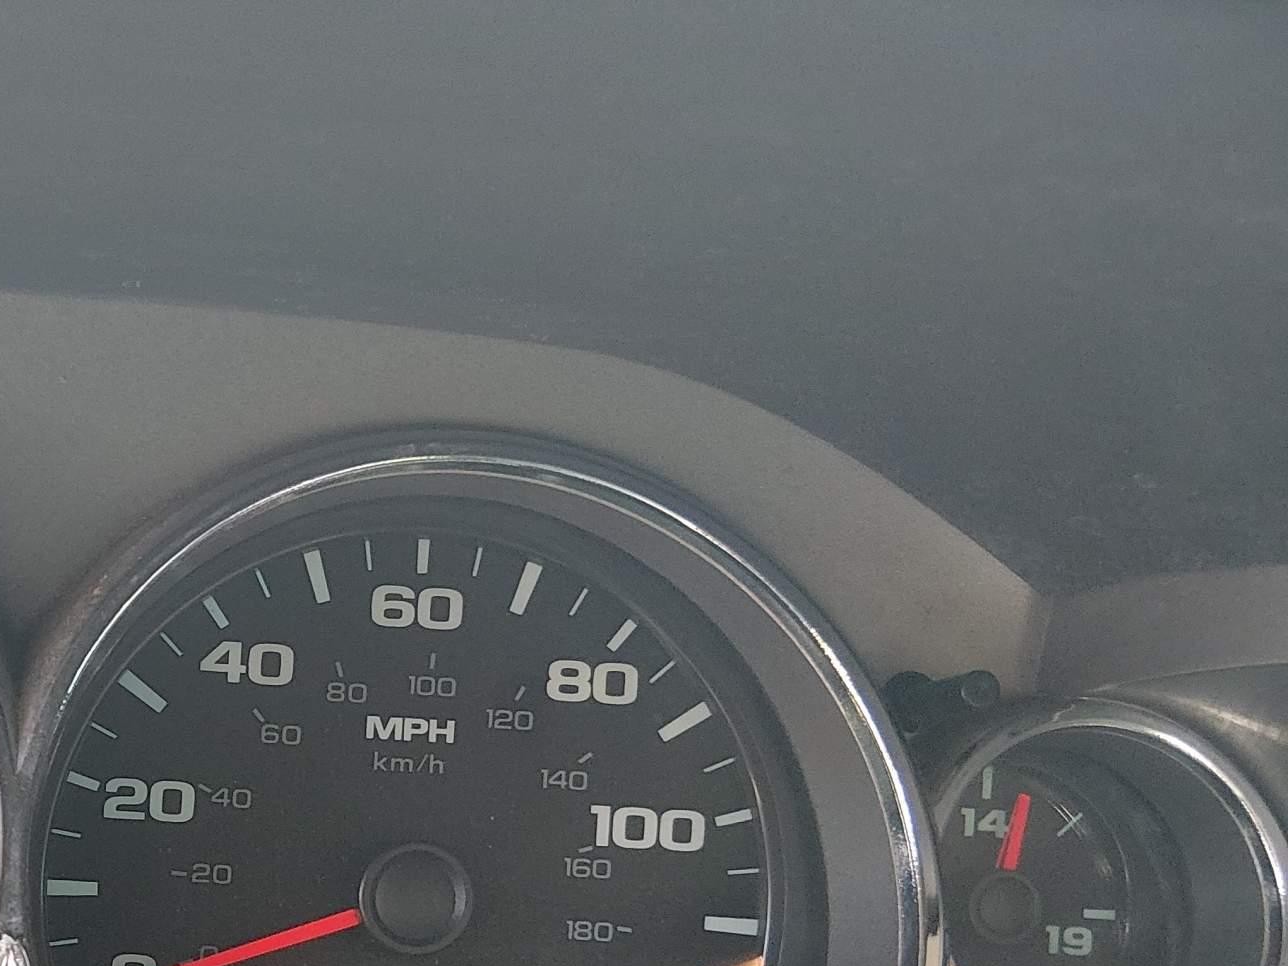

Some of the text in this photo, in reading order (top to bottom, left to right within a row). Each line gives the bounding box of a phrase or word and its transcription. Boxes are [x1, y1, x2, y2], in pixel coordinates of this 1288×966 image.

[370, 584, 464, 631] 60
[199, 640, 295, 686] 40
[326, 681, 368, 704] 80
[408, 675, 457, 698] 100
[545, 659, 639, 705] 80
[365, 714, 456, 745] MPH
[485, 708, 534, 732] 120
[261, 723, 302, 746] 60
[372, 751, 445, 775] km/h
[540, 769, 588, 791] 140
[103, 777, 196, 823] 20
[211, 787, 252, 810] 40
[589, 804, 706, 852] 100
[960, 807, 1009, 838] 14
[191, 863, 233, 885] 20
[564, 857, 612, 879] 160
[566, 920, 613, 942] 180
[1045, 925, 1093, 956] 19
